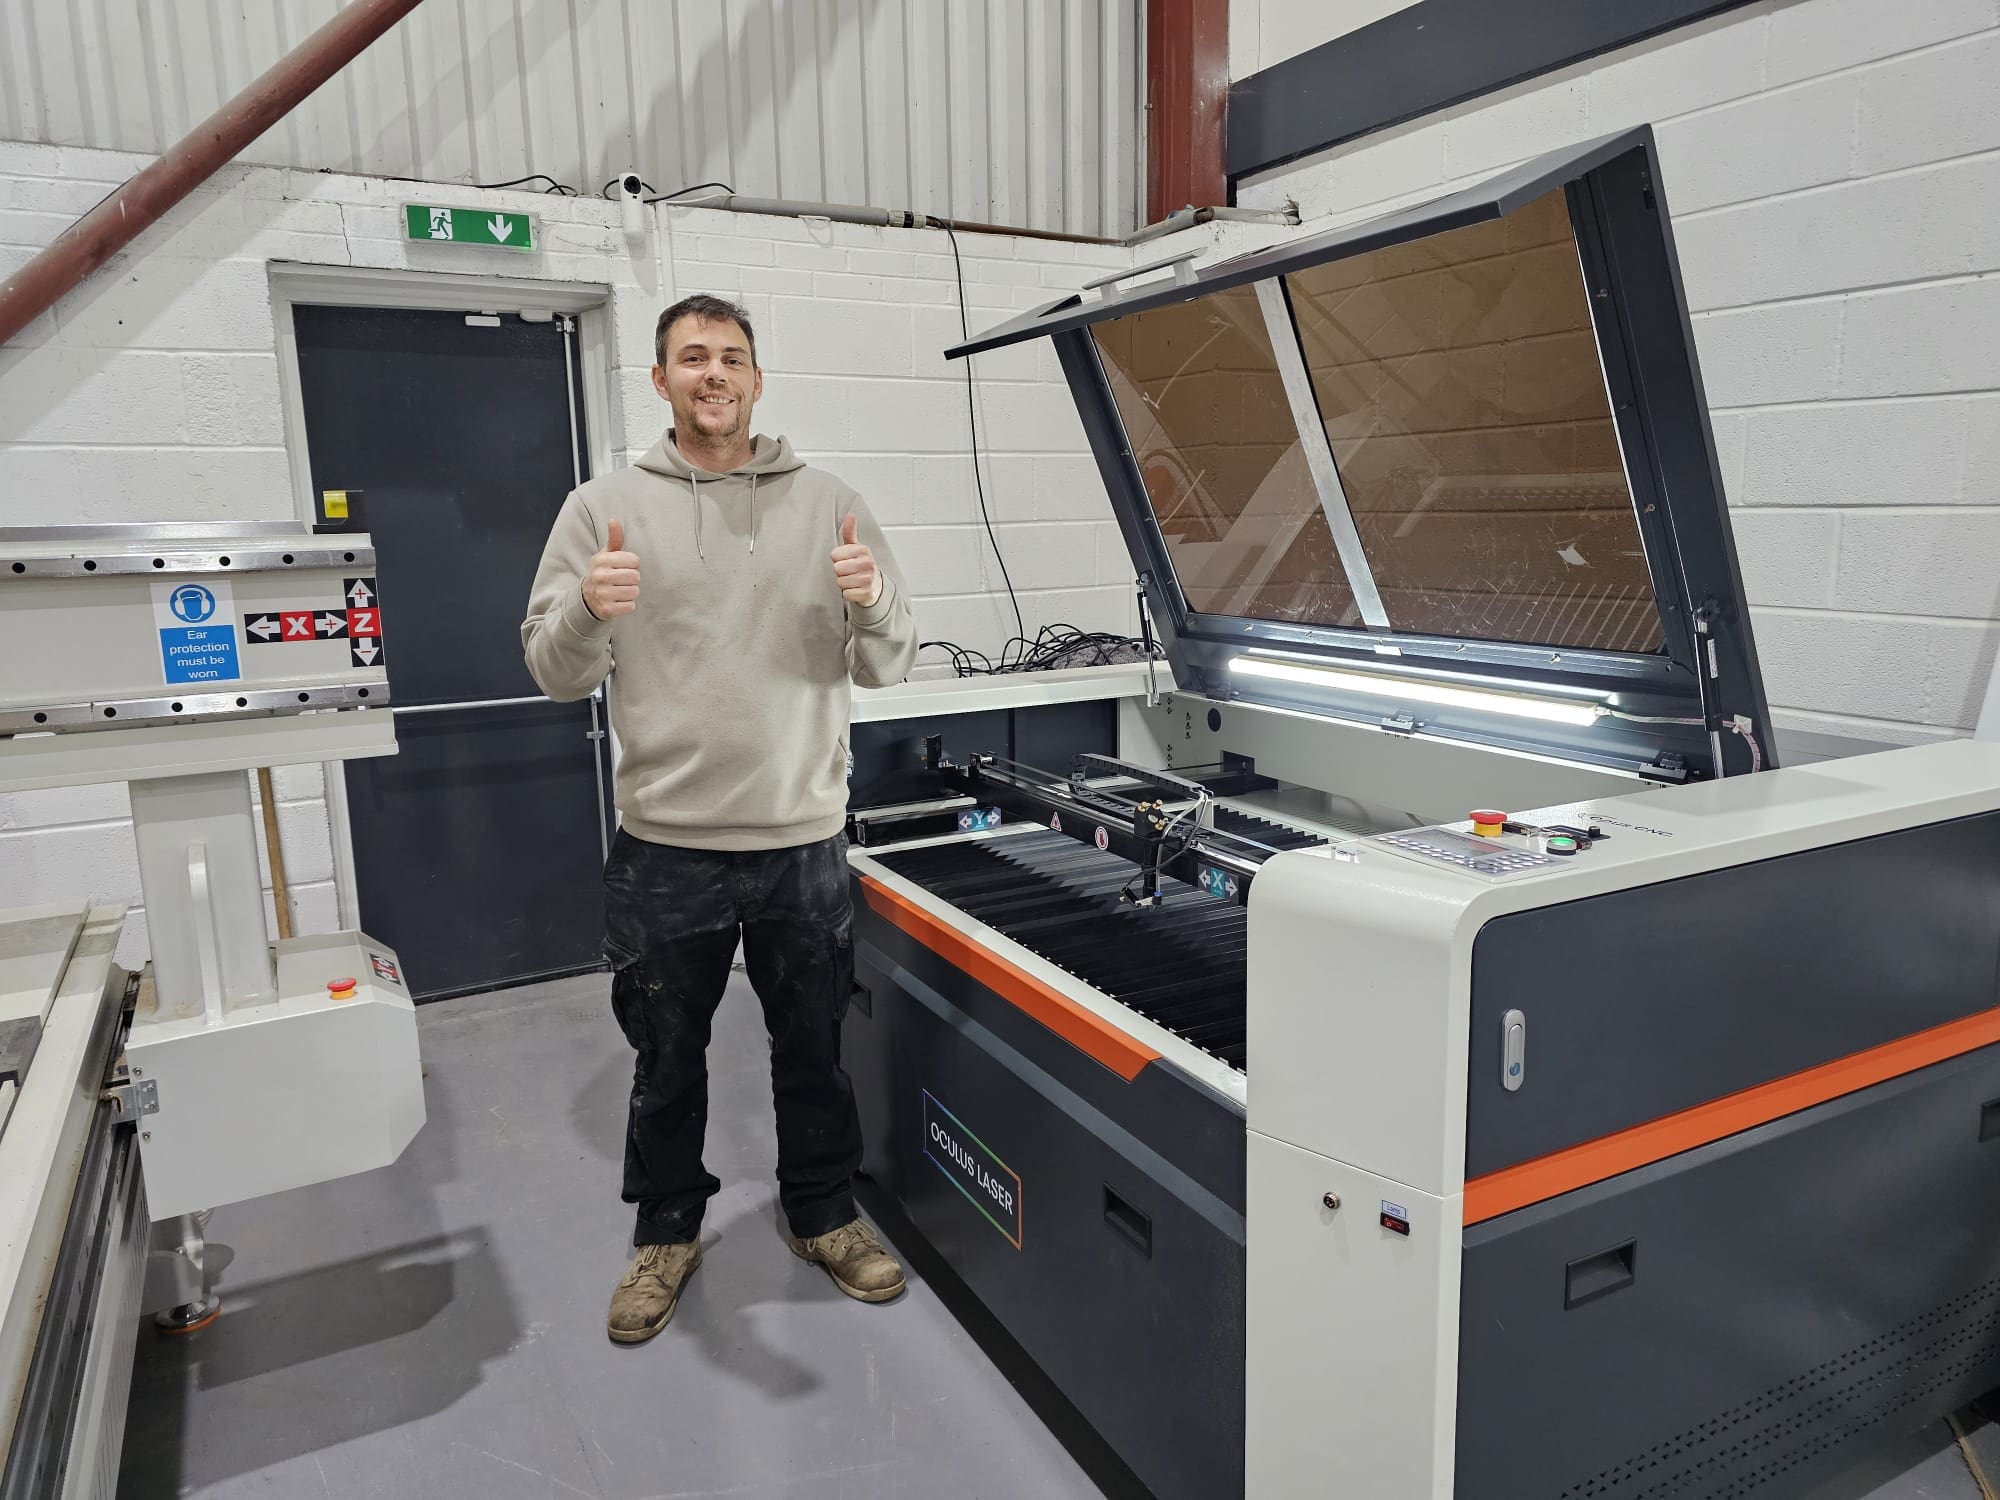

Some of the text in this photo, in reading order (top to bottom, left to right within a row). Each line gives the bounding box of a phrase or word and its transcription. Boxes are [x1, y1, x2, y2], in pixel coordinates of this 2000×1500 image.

[285, 616, 310, 636] X
[354, 612, 374, 633] Z
[187, 630, 207, 640] Ear
[169, 643, 229, 656] protection
[177, 655, 225, 667] must be
[188, 670, 218, 679] worn
[973, 811, 985, 825] Y
[1212, 870, 1224, 890] X
[930, 1121, 1013, 1216] OCULUS LASER
